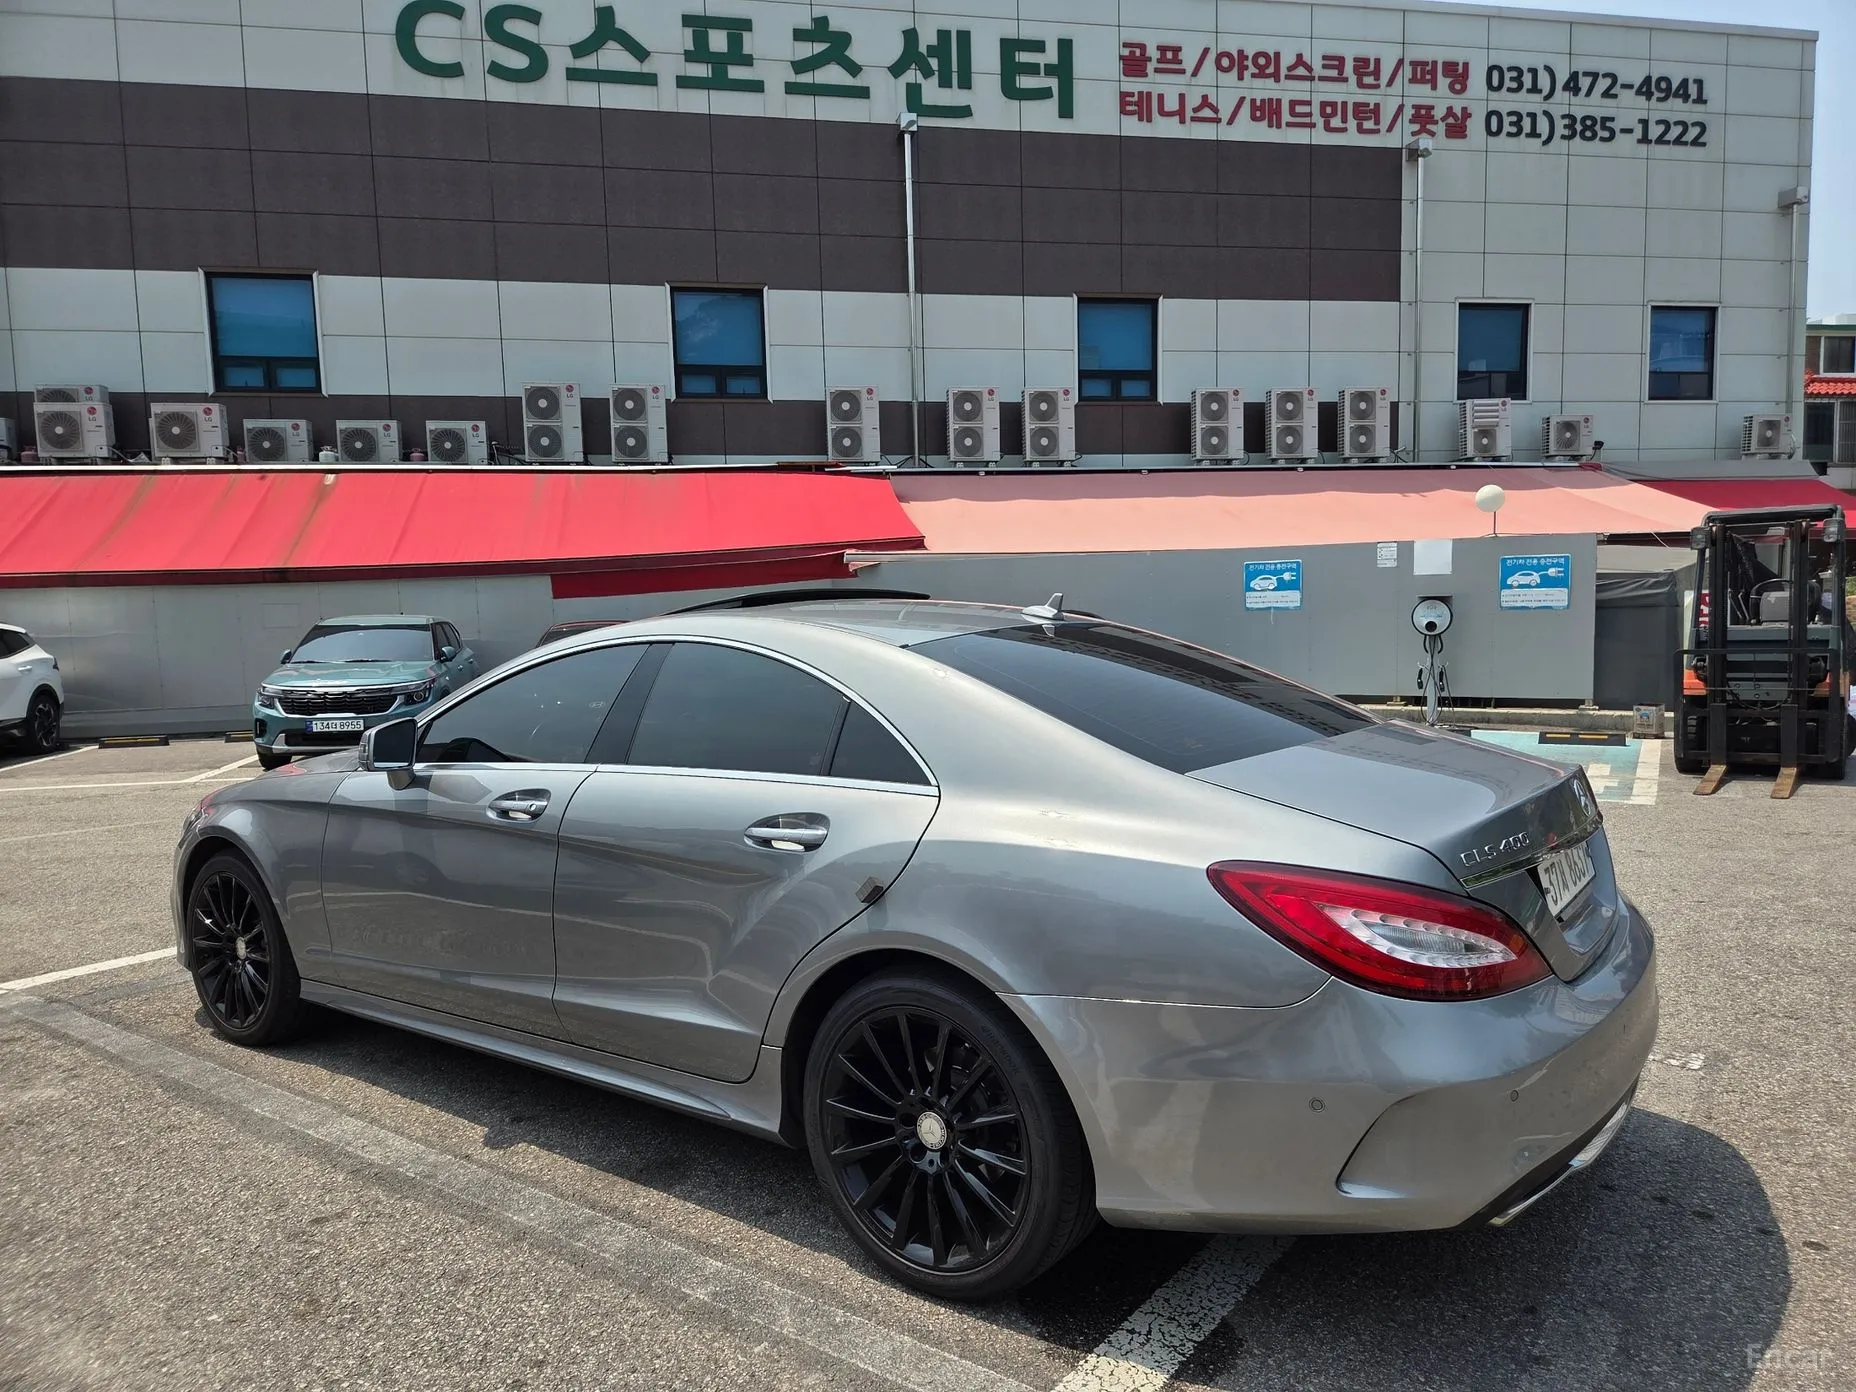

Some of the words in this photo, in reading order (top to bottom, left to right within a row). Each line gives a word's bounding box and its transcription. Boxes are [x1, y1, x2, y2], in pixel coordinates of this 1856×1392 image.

[395, 0, 1075, 120] CS스포츠센터
[1486, 64, 1708, 106] 031)472-4941
[1119, 91, 1472, 140] 테니스/배드민턴/풋살
[1485, 108, 1708, 148] 031)385-1222
[339, 720, 362, 730] 8955
[1460, 843, 1497, 867] CLS
[1499, 831, 1530, 852] 400
